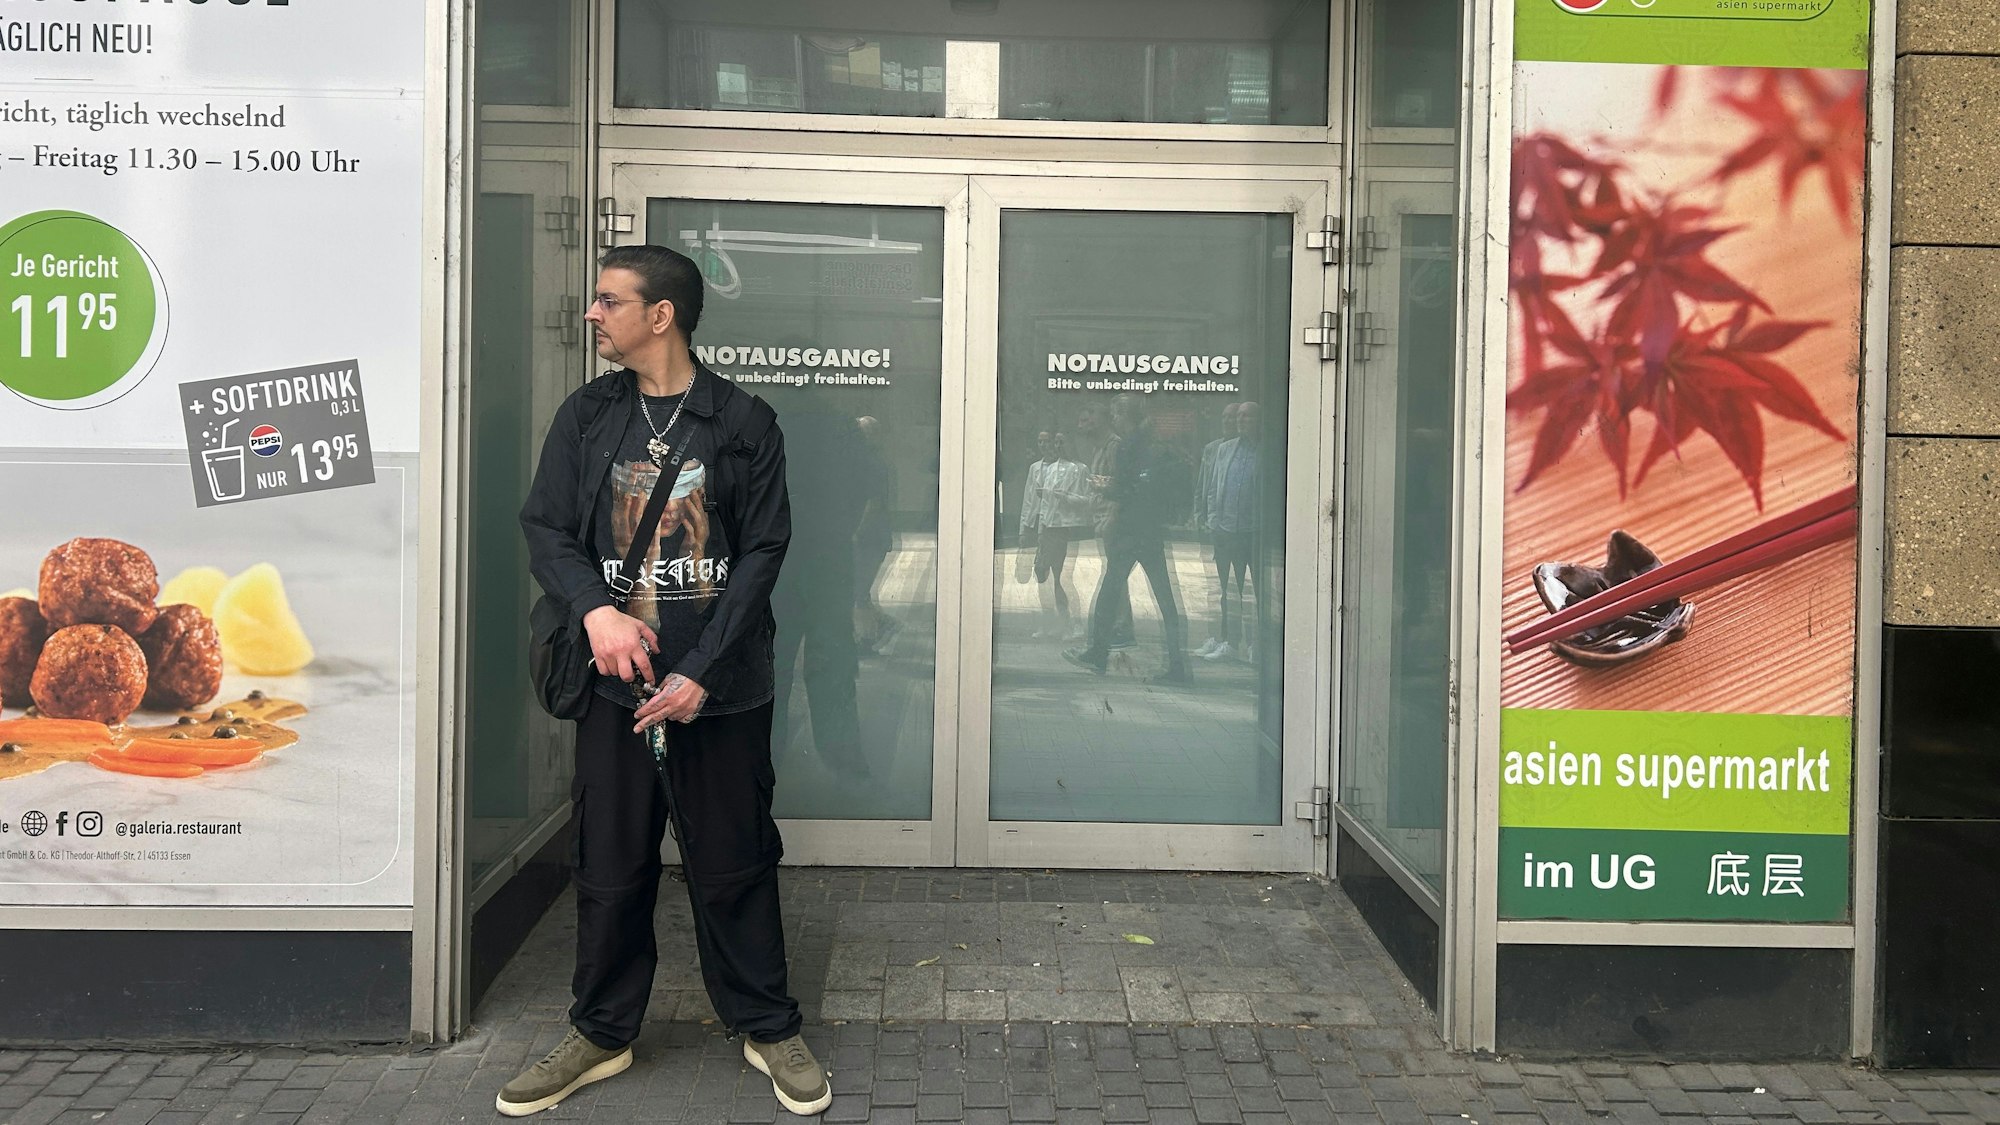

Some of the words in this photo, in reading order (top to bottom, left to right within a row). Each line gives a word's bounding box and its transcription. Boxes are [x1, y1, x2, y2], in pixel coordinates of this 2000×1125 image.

[1717, 0, 1748, 9] asien
[1753, 1, 1821, 12] supermarkt
[92, 23, 152, 54] NEU!
[0, 99, 57, 126] icht,
[66, 102, 149, 131] täglich
[157, 104, 286, 128] wechselnd
[33, 145, 118, 175] Freitag
[128, 147, 197, 171] 11.30
[232, 149, 301, 173] 15.00
[311, 150, 360, 173] Uhr
[11, 253, 35, 277] Je
[41, 254, 119, 279] Gericht
[696, 345, 891, 369] NOTAUSGANG!
[1047, 353, 1239, 375] NOTAUSGANG!
[736, 372, 810, 387] unbedingt
[814, 372, 891, 386] freihalten.
[1047, 378, 1082, 390] Bitte
[1086, 379, 1159, 394] unbedingt
[1163, 380, 1239, 392] freihalten.
[212, 369, 358, 417] SOFTDRINK
[330, 401, 350, 417] 0,3
[352, 399, 360, 413] L
[250, 435, 281, 447] PEPSI
[256, 470, 288, 489] NUR
[1503, 741, 1601, 786] asien
[1615, 746, 1830, 799] supermarkt
[115, 821, 242, 838] @galeria.restaurant
[7, 850, 28, 860] GmbH
[37, 851, 49, 860] Co.
[51, 851, 60, 860] KG
[137, 851, 142, 860] 2
[147, 851, 169, 861] 45133
[170, 851, 191, 861] Essen
[1523, 852, 1574, 889] im
[1590, 853, 1656, 890] UG
[1706, 851, 1805, 898] 底层
